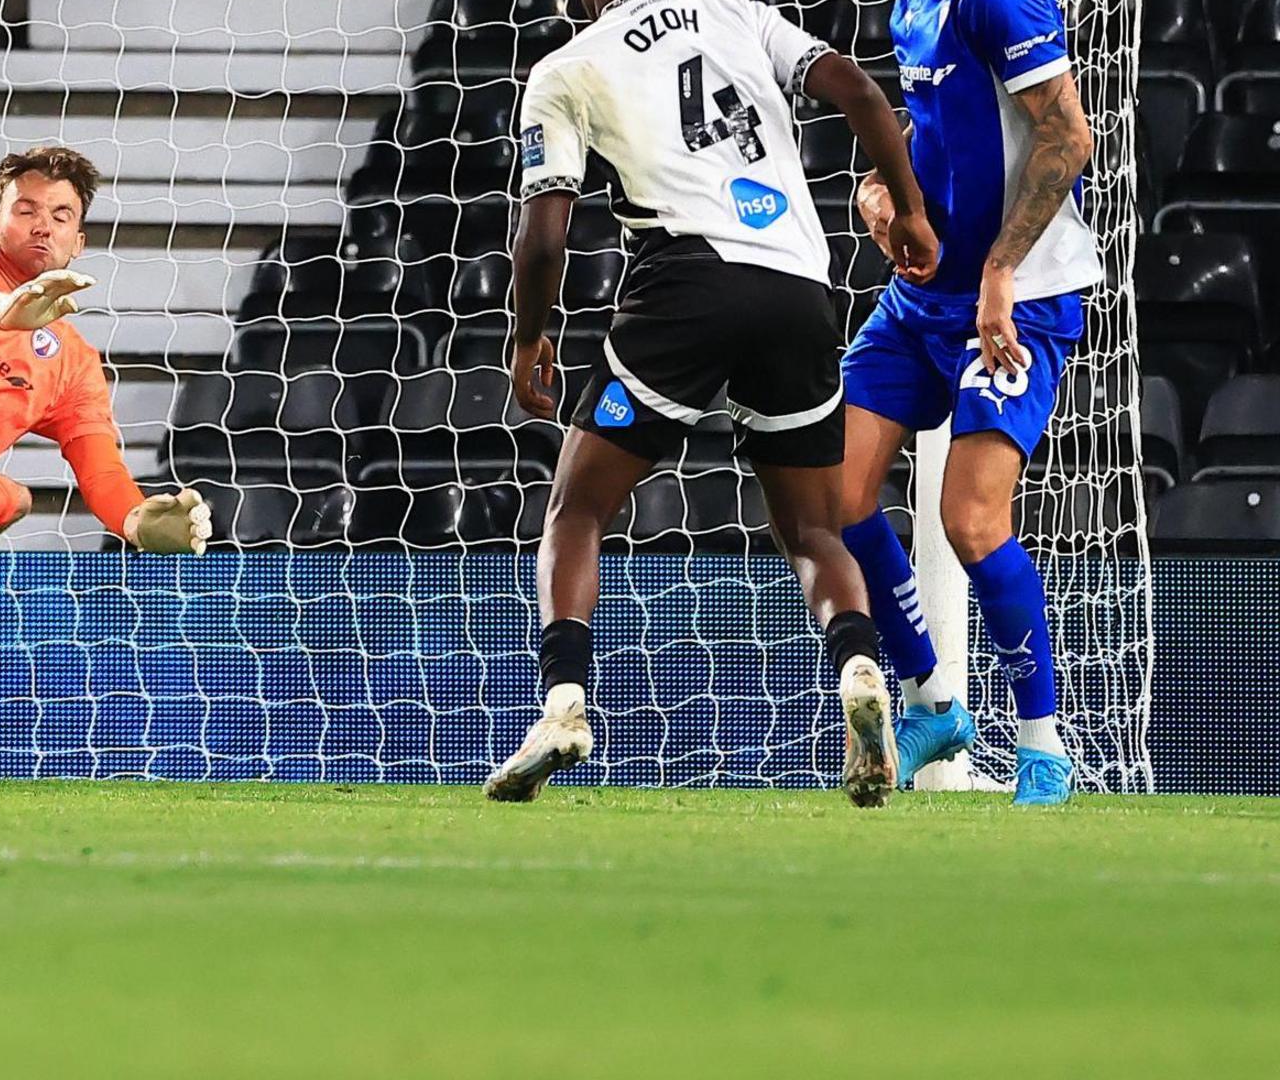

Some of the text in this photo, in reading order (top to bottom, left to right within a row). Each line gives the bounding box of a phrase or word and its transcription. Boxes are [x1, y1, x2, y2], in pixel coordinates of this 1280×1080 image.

[623, 7, 700, 53] OZOH
[677, 54, 767, 166] 4
[736, 194, 778, 218] hsg
[600, 394, 629, 421] hsg
